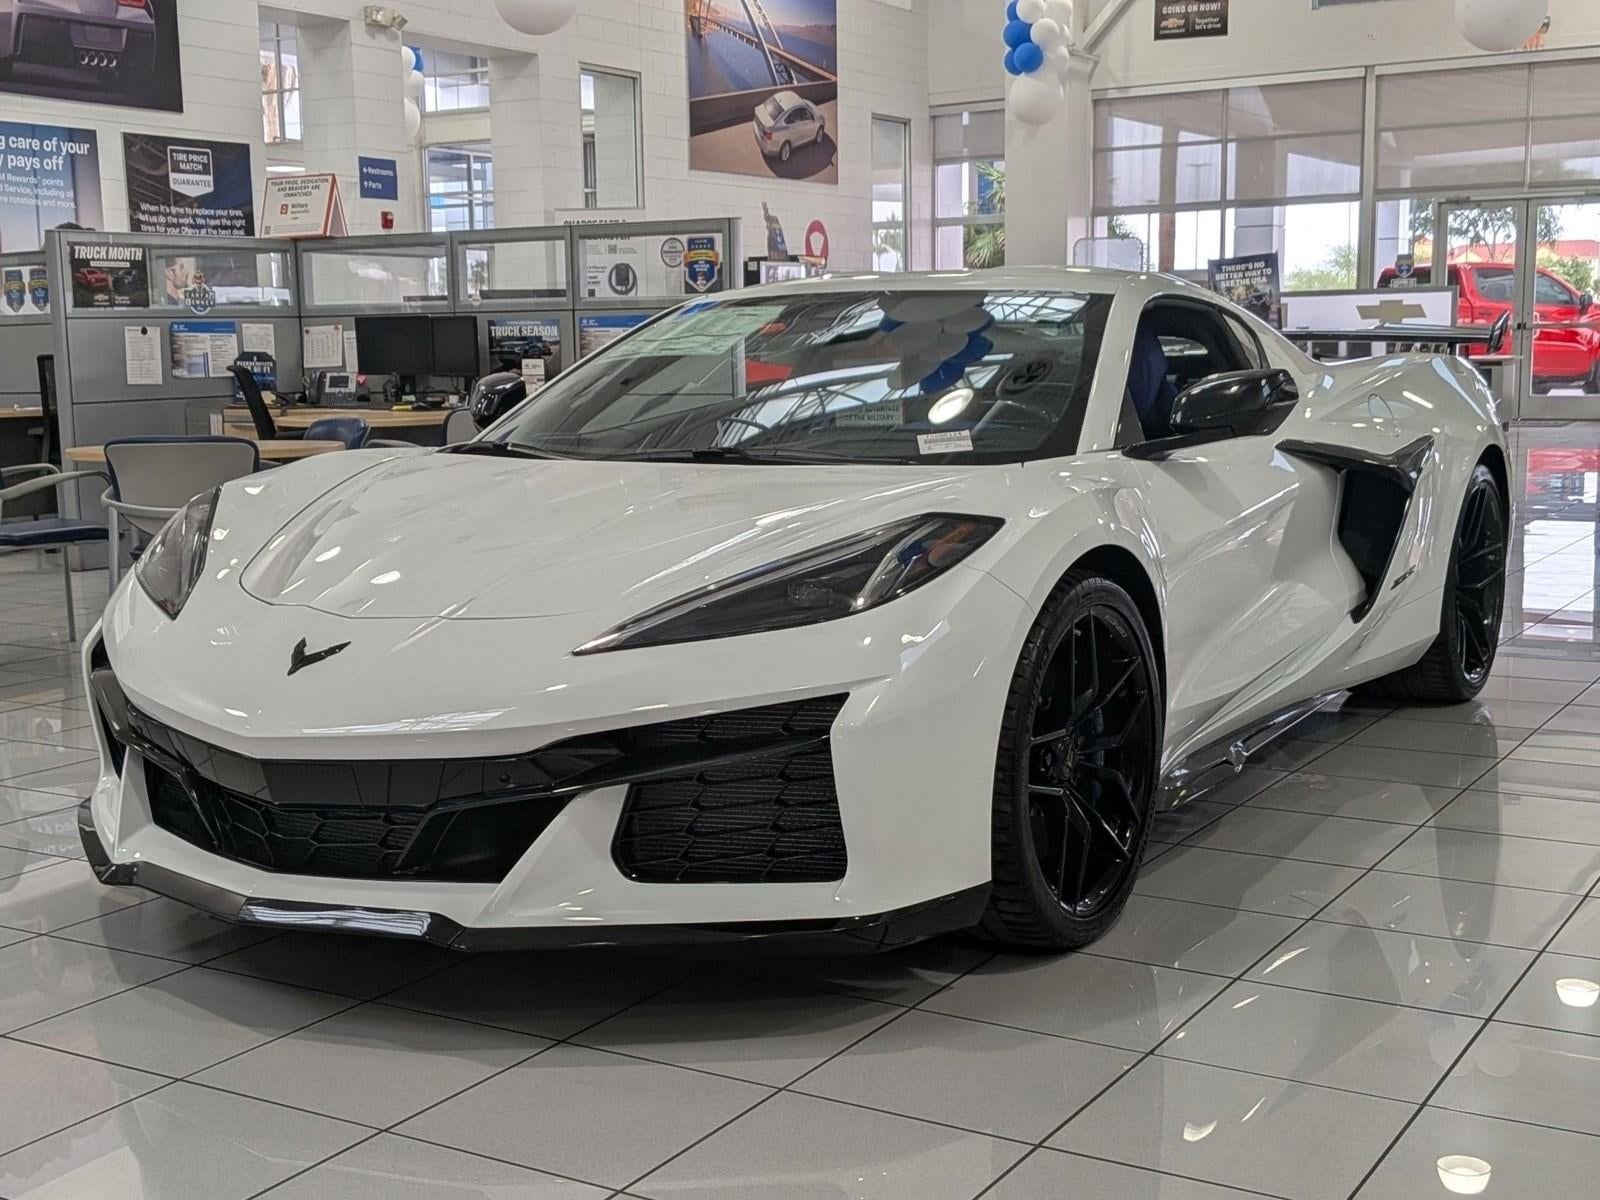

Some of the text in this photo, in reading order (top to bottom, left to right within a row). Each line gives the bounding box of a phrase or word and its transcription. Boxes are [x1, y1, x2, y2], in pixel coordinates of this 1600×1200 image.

[1162, 2, 1221, 14] GOING ON NOW!
[9, 136, 40, 150] care
[43, 137, 58, 152] of
[60, 141, 90, 156] your
[7, 154, 40, 171] pays
[43, 155, 64, 171] off
[172, 152, 208, 164] TIRE PRICE
[180, 162, 203, 171] MATCH
[74, 246, 143, 261] TRUCK MONTH
[1222, 262, 1253, 272] THERE'S
[490, 326, 558, 337] TRUCK SEASON
